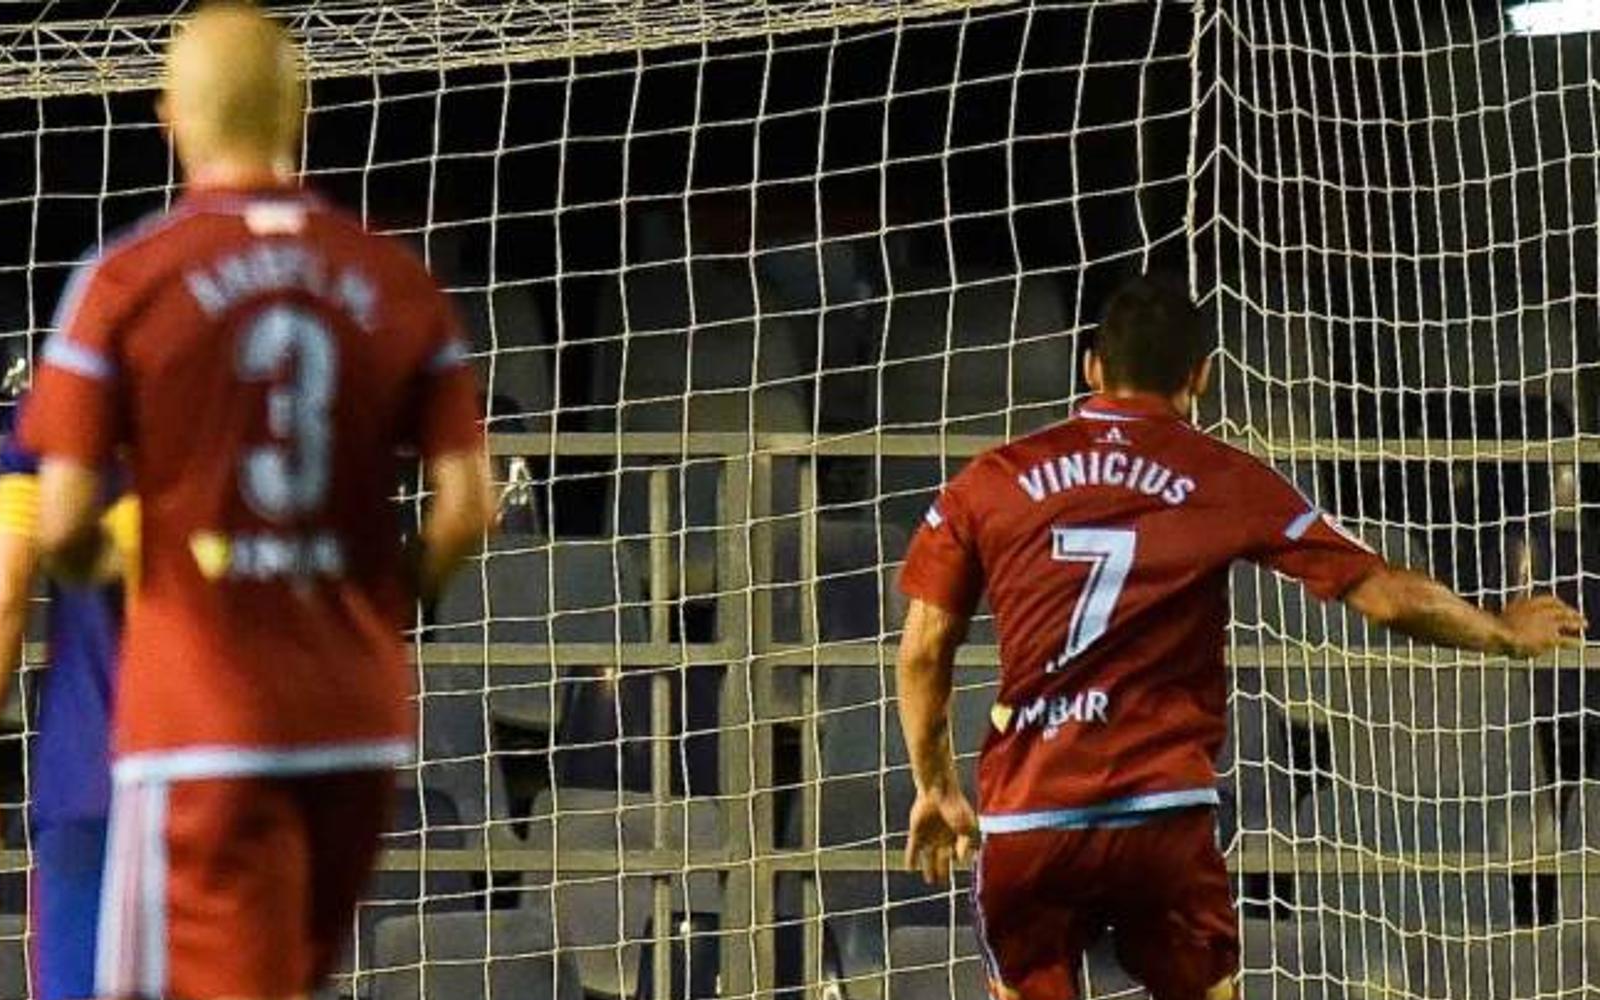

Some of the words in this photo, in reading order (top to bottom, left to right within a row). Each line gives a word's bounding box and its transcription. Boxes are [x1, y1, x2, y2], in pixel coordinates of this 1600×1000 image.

[236, 306, 338, 521] 3
[1017, 450, 1197, 506] VINICIUS
[1045, 524, 1138, 673] 7
